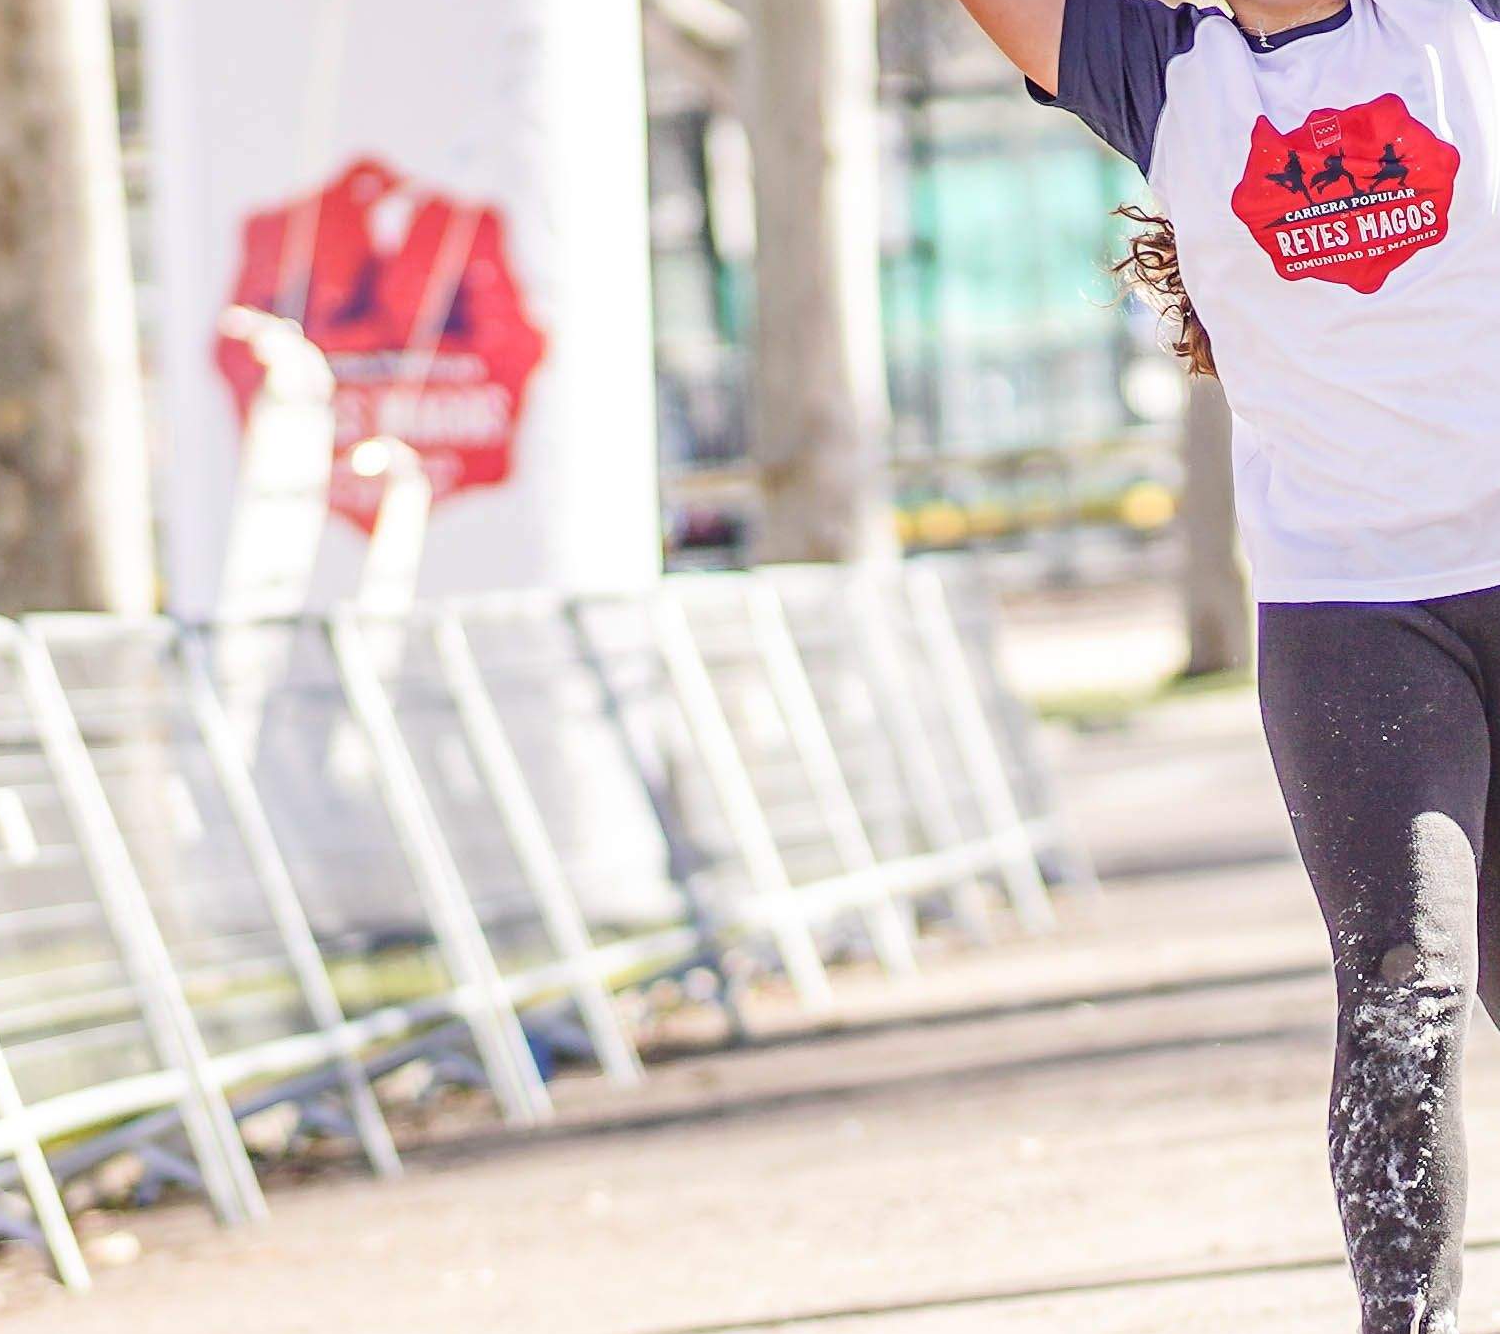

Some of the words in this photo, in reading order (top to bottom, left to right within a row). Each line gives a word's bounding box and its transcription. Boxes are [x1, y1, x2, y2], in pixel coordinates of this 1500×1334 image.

[1285, 200, 1349, 222] CARRERA
[1351, 188, 1416, 208] POPULAR
[1276, 220, 1350, 257] REYES
[1356, 200, 1437, 243] MAGOS
[1286, 250, 1364, 273] COMUNIDAD
[1367, 246, 1386, 257] DE
[1387, 229, 1438, 252] MADRID
